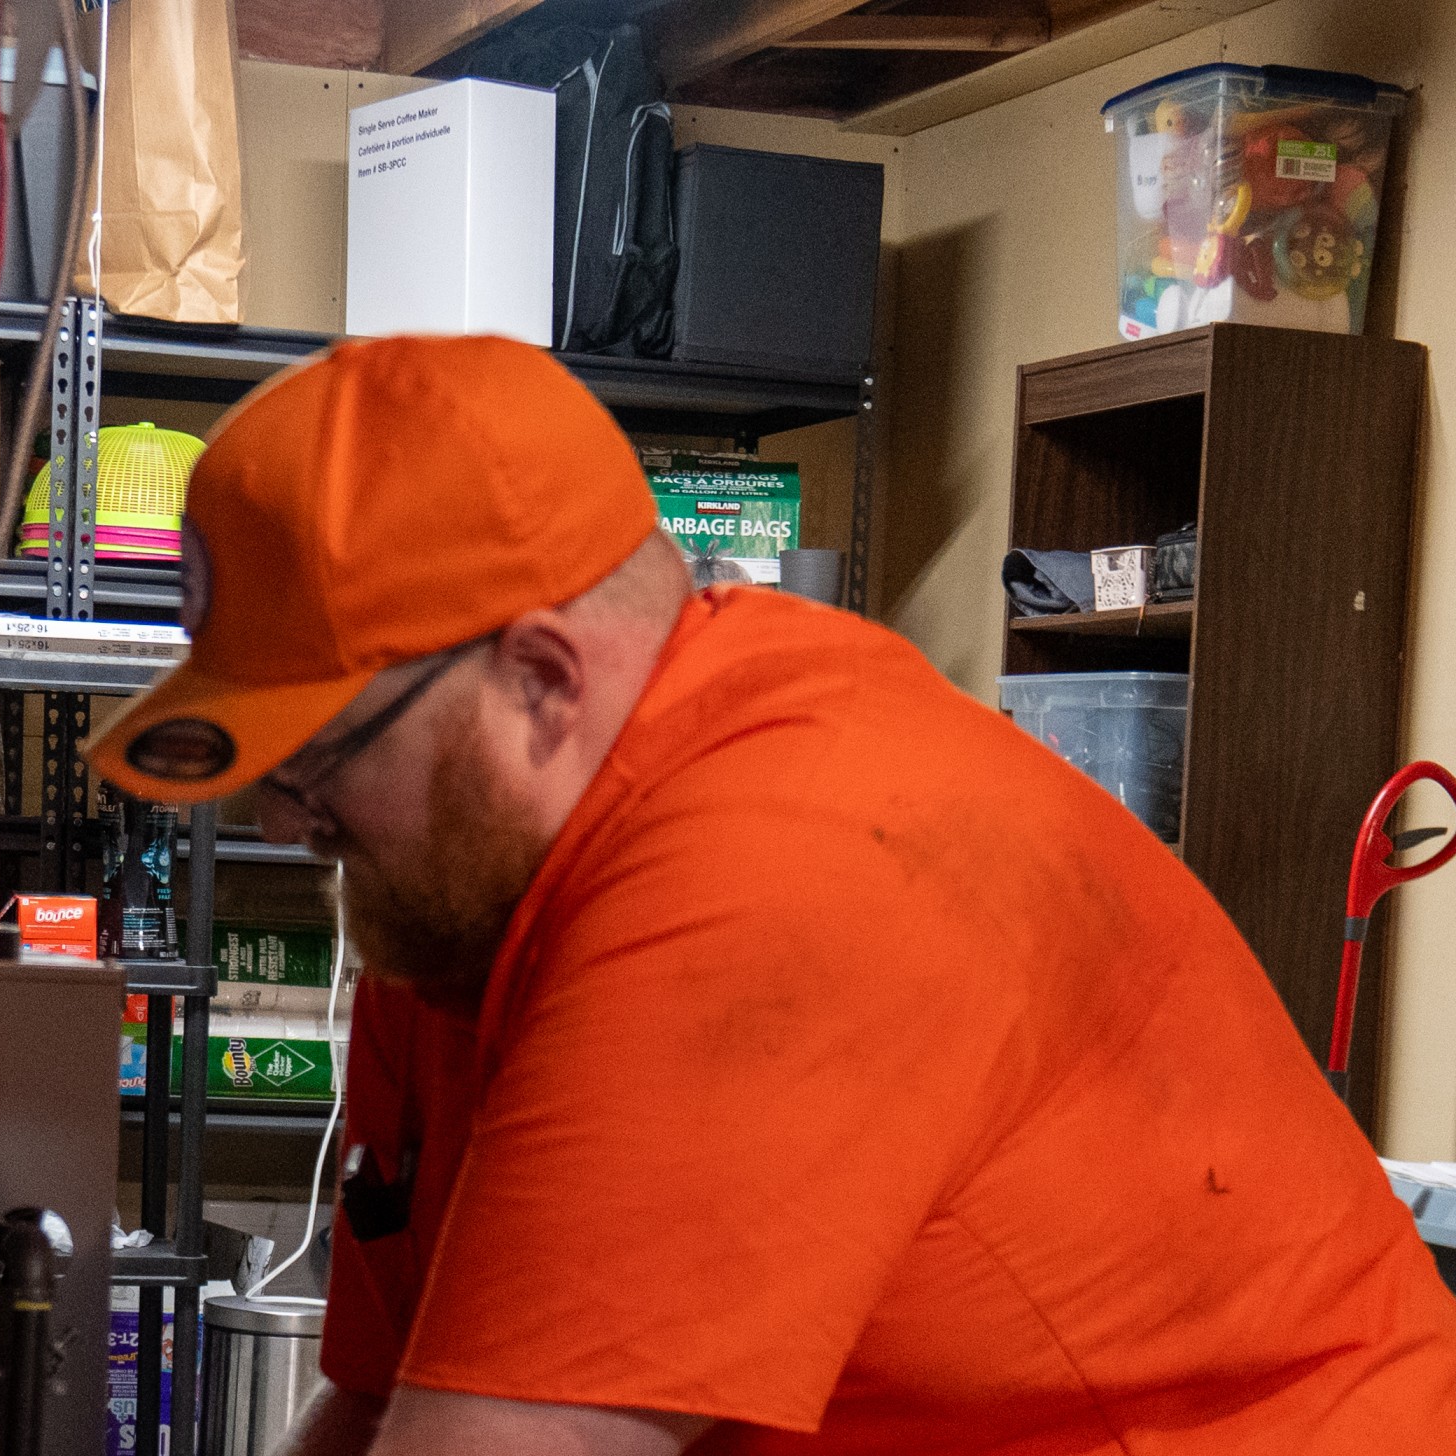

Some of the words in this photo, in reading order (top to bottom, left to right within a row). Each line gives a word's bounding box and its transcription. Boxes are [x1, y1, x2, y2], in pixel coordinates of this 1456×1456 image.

[358, 123, 376, 135] Single
[378, 119, 395, 130] Serve
[396, 113, 416, 125] Coffee
[418, 107, 438, 119] Maker
[392, 136, 414, 149] portion
[415, 125, 450, 141] individuelle
[358, 167, 372, 178] Item
[698, 458, 741, 467] KIRKLAND
[653, 475, 692, 486] SACS
[712, 478, 785, 489] ORDURES
[659, 468, 733, 478] GARBAGE
[737, 473, 778, 481] BAGS
[697, 501, 741, 511] KIRKLAND
[661, 517, 736, 535] ARBAGE
[740, 520, 792, 538] BAGS
[35, 906, 85, 924] bounce
[228, 932, 239, 980] STRONGEST
[229, 1038, 252, 1086] Bounty
